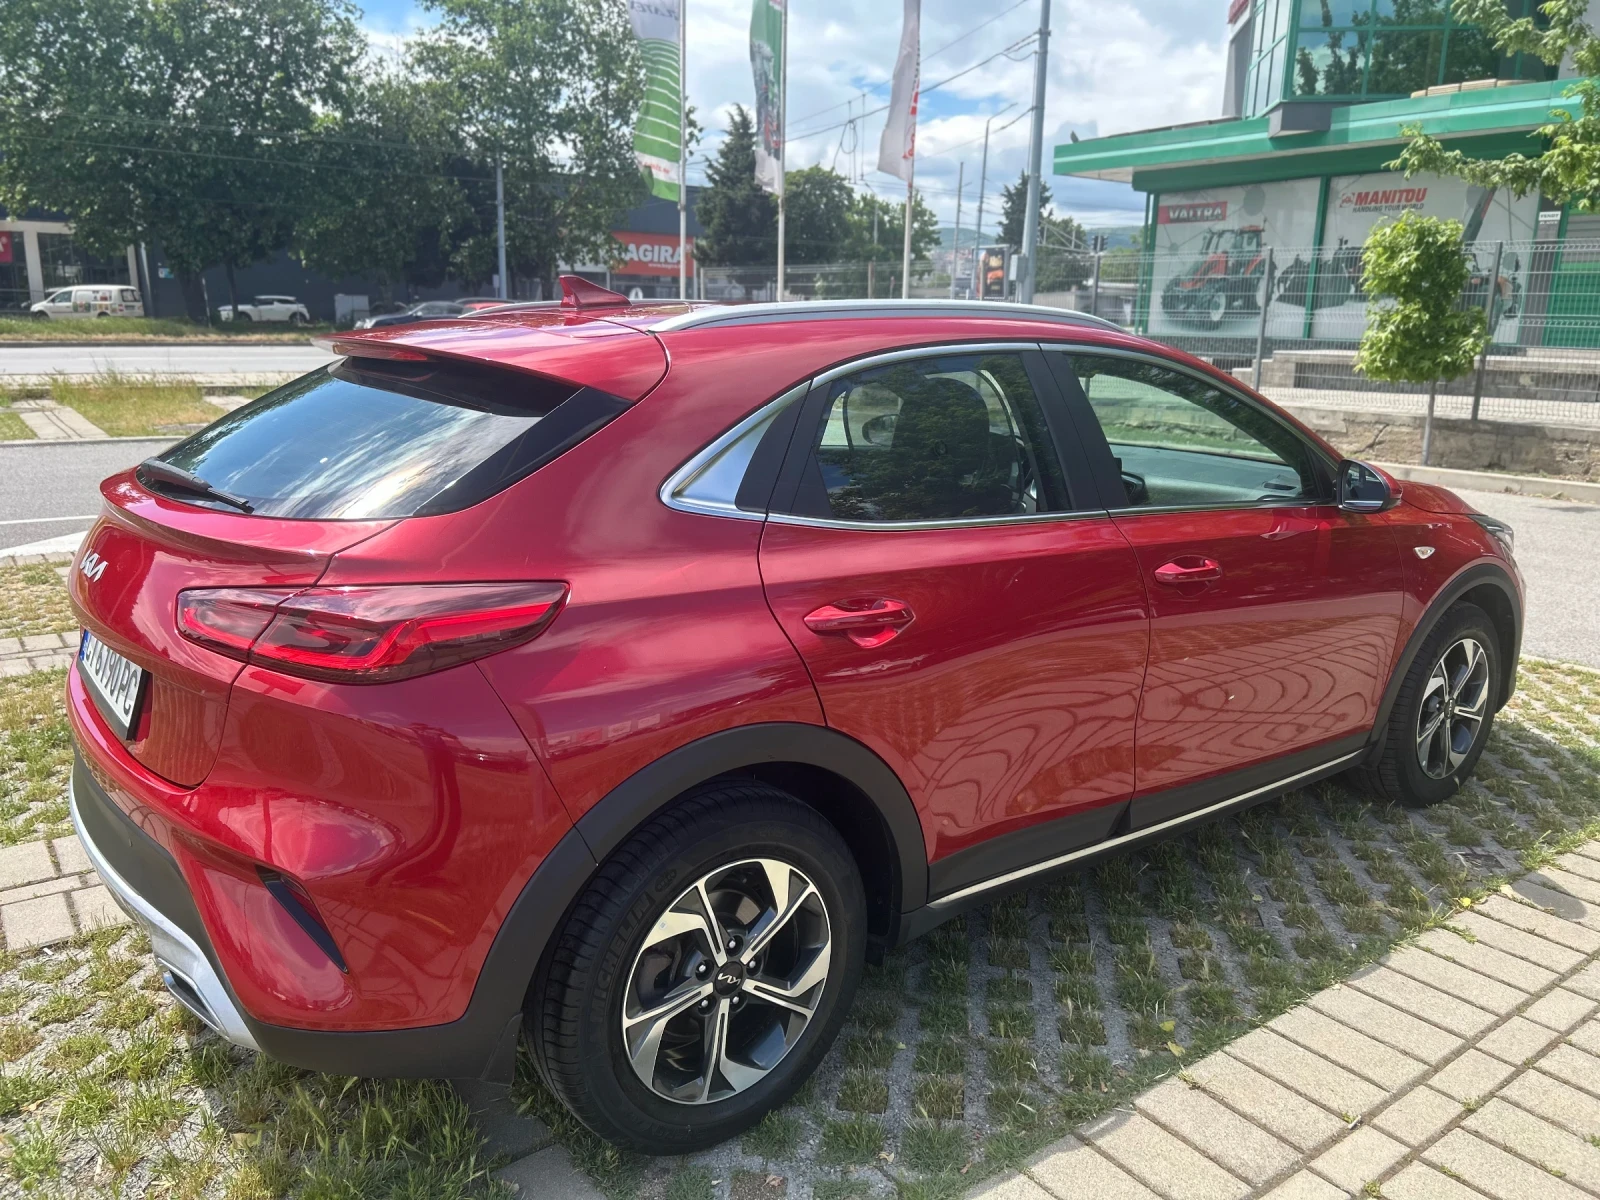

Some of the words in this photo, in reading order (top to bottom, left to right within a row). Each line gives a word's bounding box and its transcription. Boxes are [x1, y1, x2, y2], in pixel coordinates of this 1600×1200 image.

[1354, 187, 1428, 206] MANITOU
[1168, 206, 1222, 220] VALTRA
[1352, 205, 1383, 213] HANDLING
[1384, 204, 1401, 212] YOUR
[79, 548, 109, 582] KIA
[590, 891, 653, 1024] MICHELIN
